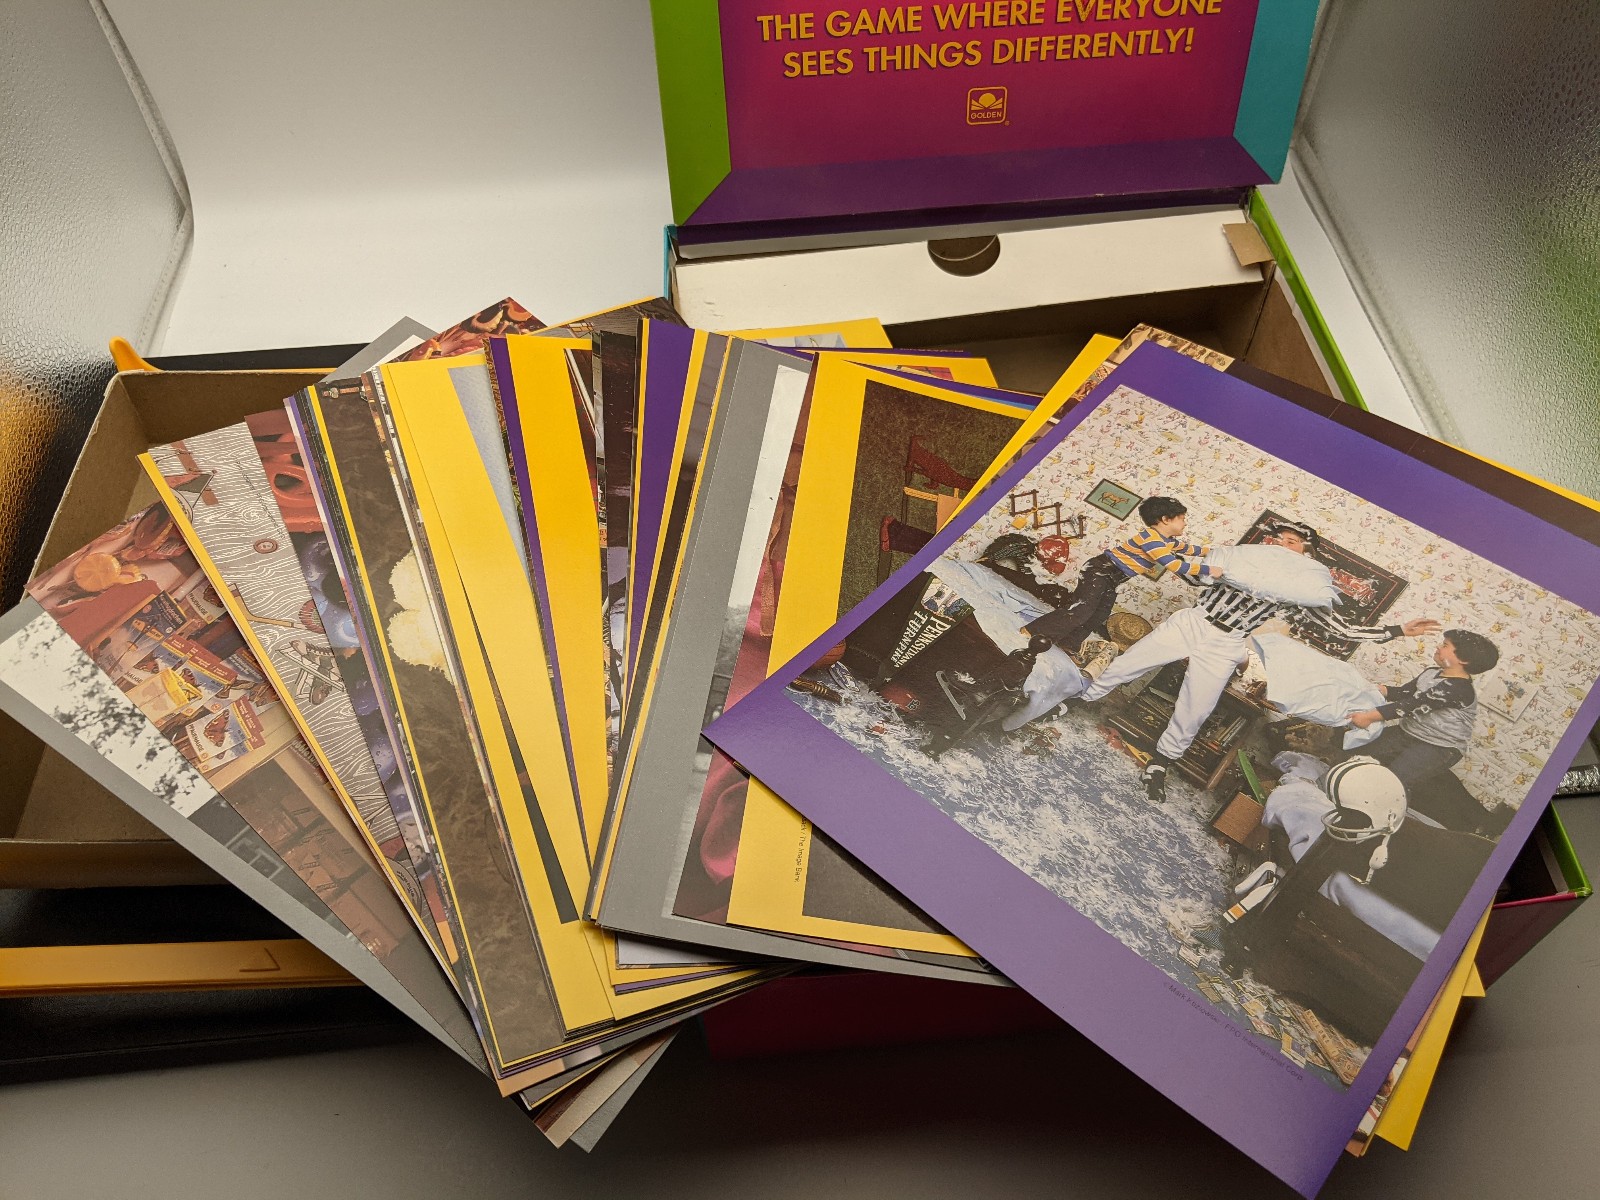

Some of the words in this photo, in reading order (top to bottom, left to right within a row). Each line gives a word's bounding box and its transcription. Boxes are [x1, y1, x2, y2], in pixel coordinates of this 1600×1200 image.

[757, 13, 815, 41] THE
[826, 6, 923, 38] GAME
[933, 0, 1045, 31] WHERE
[1056, 0, 1222, 23] EVERYONE
[783, 49, 854, 78] SEES
[864, 40, 982, 72] THINGS
[993, 27, 1195, 64] DIFFERENTLY!
[970, 111, 1003, 120] GOLDEN
[890, 610, 929, 662] TURNPIKE
[894, 616, 952, 668] PENNSYLVANIA
